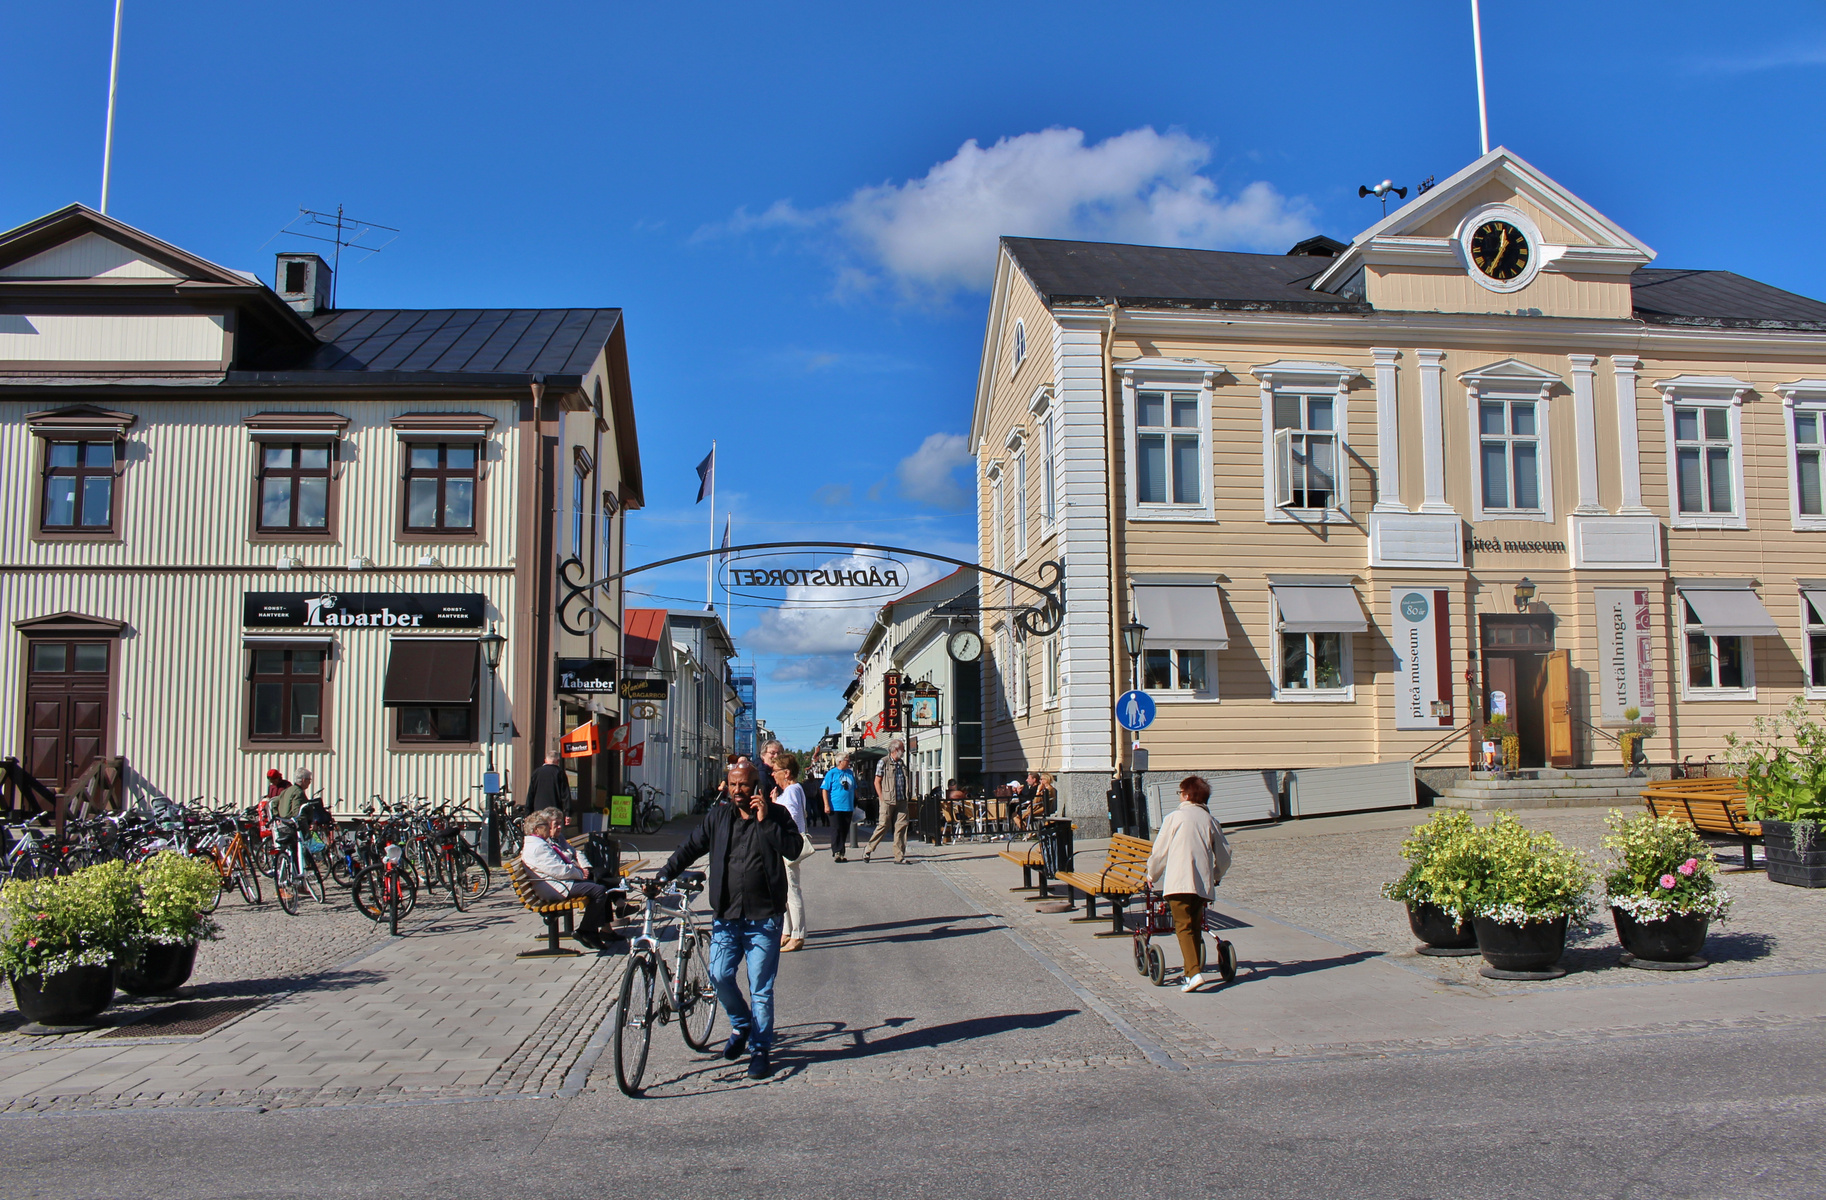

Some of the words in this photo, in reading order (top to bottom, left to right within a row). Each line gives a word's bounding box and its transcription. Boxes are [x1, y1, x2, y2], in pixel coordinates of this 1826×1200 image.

[1464, 536, 1500, 553] piteå
[1504, 540, 1566, 551] museum
[303, 594, 423, 626] rabarber
[1406, 605, 1418, 615] 80
[1410, 628, 1420, 684] museum
[1612, 602, 1627, 706] utställningar.
[560, 671, 614, 688] rabarber
[888, 676, 898, 728] HOTEL
[1409, 687, 1424, 718] piteå
[862, 721, 876, 739] Å
